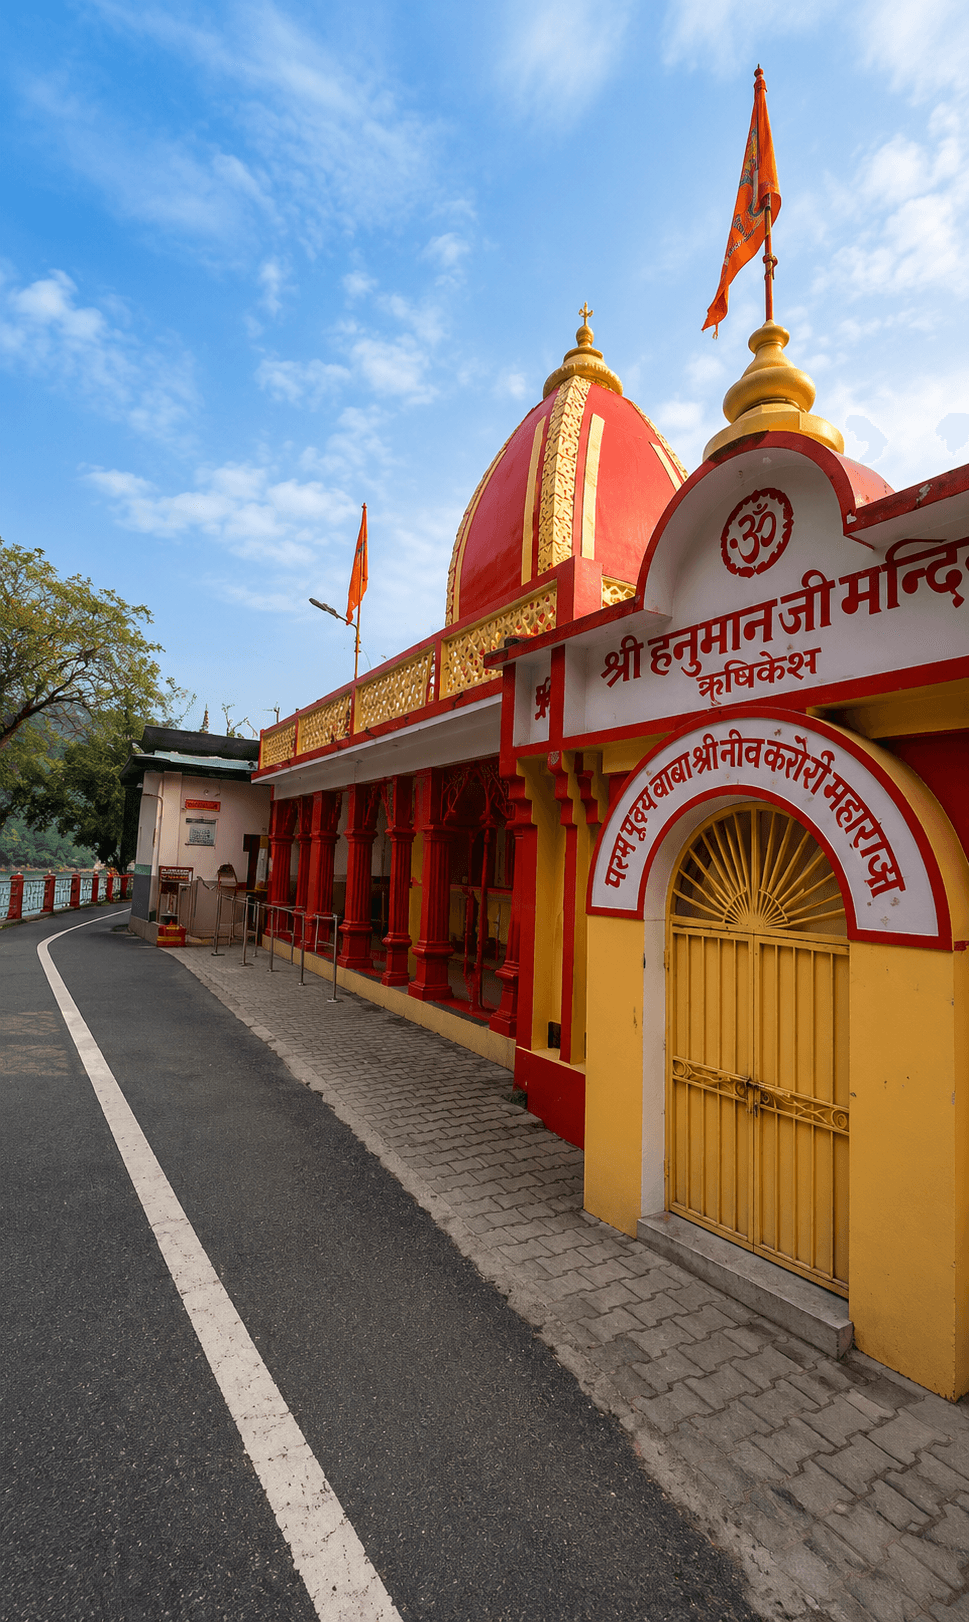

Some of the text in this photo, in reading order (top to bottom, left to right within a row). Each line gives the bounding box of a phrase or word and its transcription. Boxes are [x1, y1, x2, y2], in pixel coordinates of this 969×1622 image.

[600, 539, 969, 688] श्री हनुमान जी मन्दि
[696, 647, 823, 707] ऋषिकेश
[604, 832, 637, 889] परम
[691, 733, 720, 775] श्री
